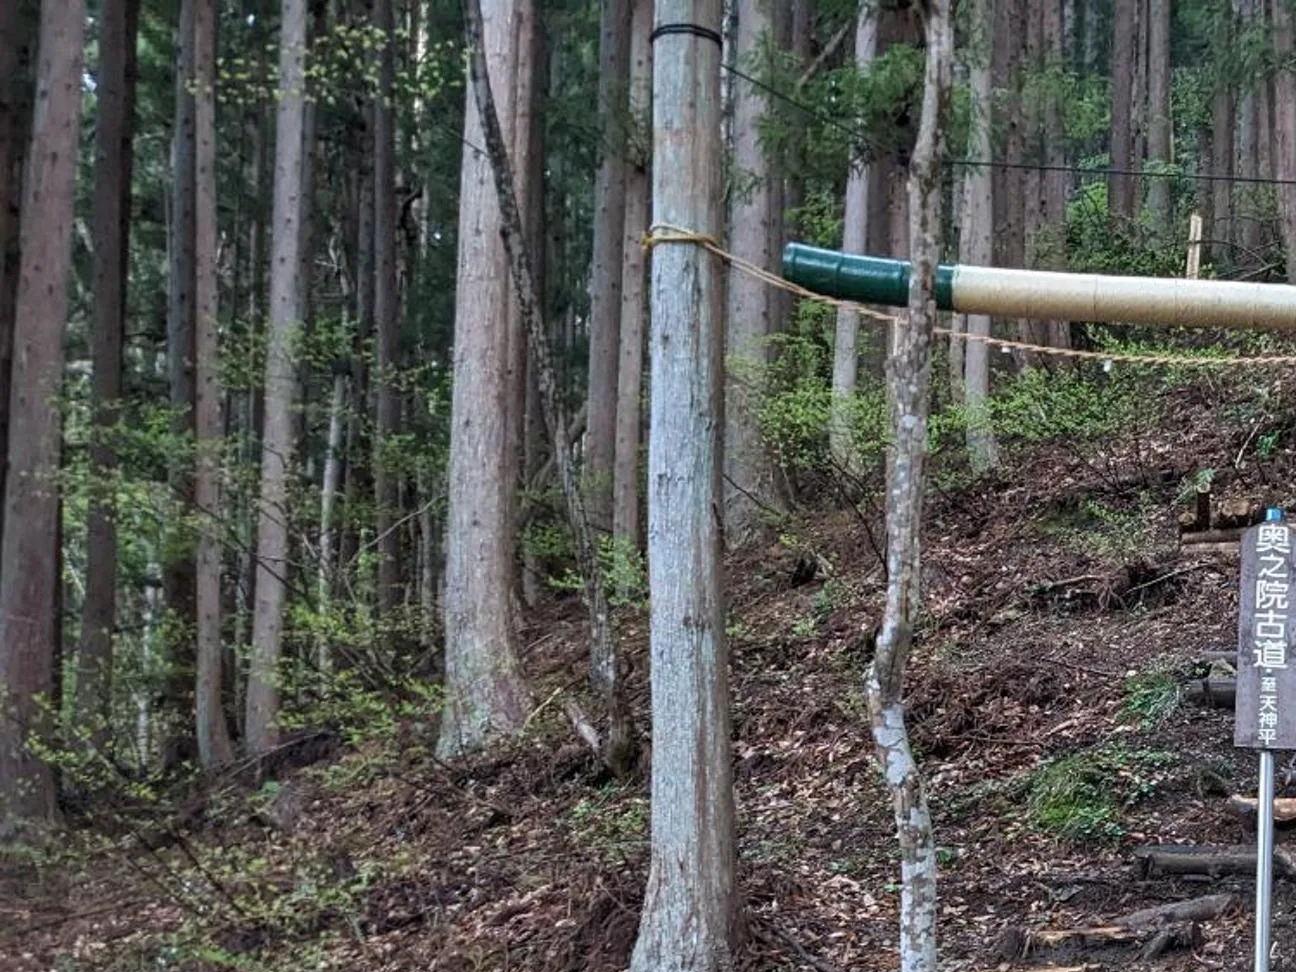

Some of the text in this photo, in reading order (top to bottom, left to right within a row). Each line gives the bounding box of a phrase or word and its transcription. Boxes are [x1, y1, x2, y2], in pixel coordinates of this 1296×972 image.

[1253, 523, 1291, 668] 奥之院古道
[1258, 677, 1278, 746] 至天神平
